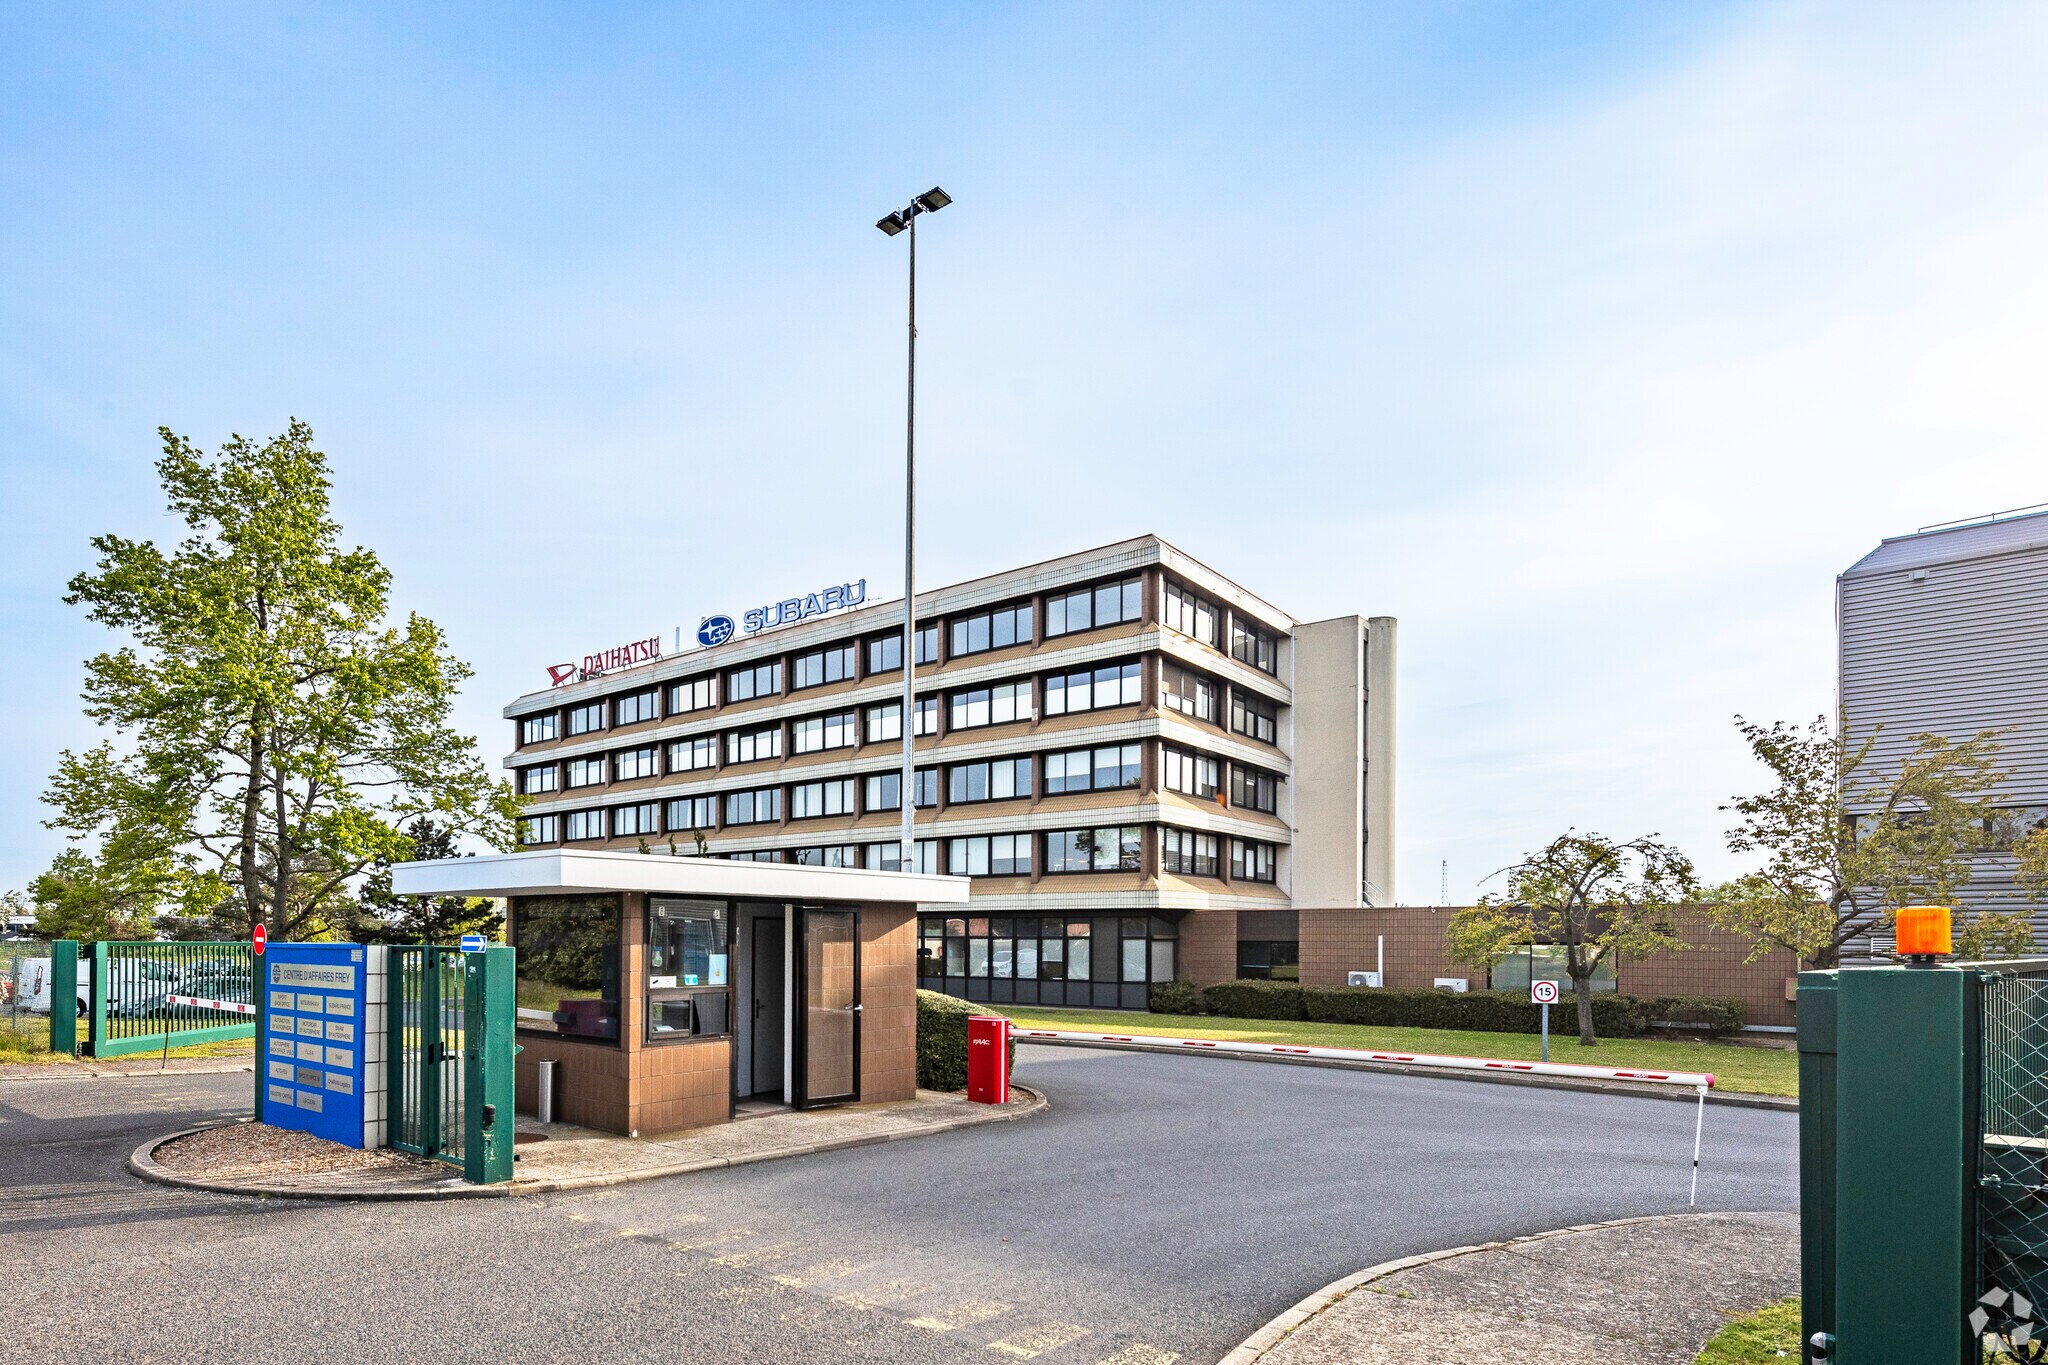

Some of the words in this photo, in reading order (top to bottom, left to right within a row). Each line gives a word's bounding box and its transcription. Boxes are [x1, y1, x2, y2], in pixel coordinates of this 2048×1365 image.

[743, 579, 866, 633] SUBARU
[583, 636, 660, 676] DAIHATSU
[283, 969, 303, 980] CENTRE
[304, 970, 334, 982] D'AFFAIRES
[335, 972, 350, 983] FREY
[1539, 987, 1551, 996] 15
